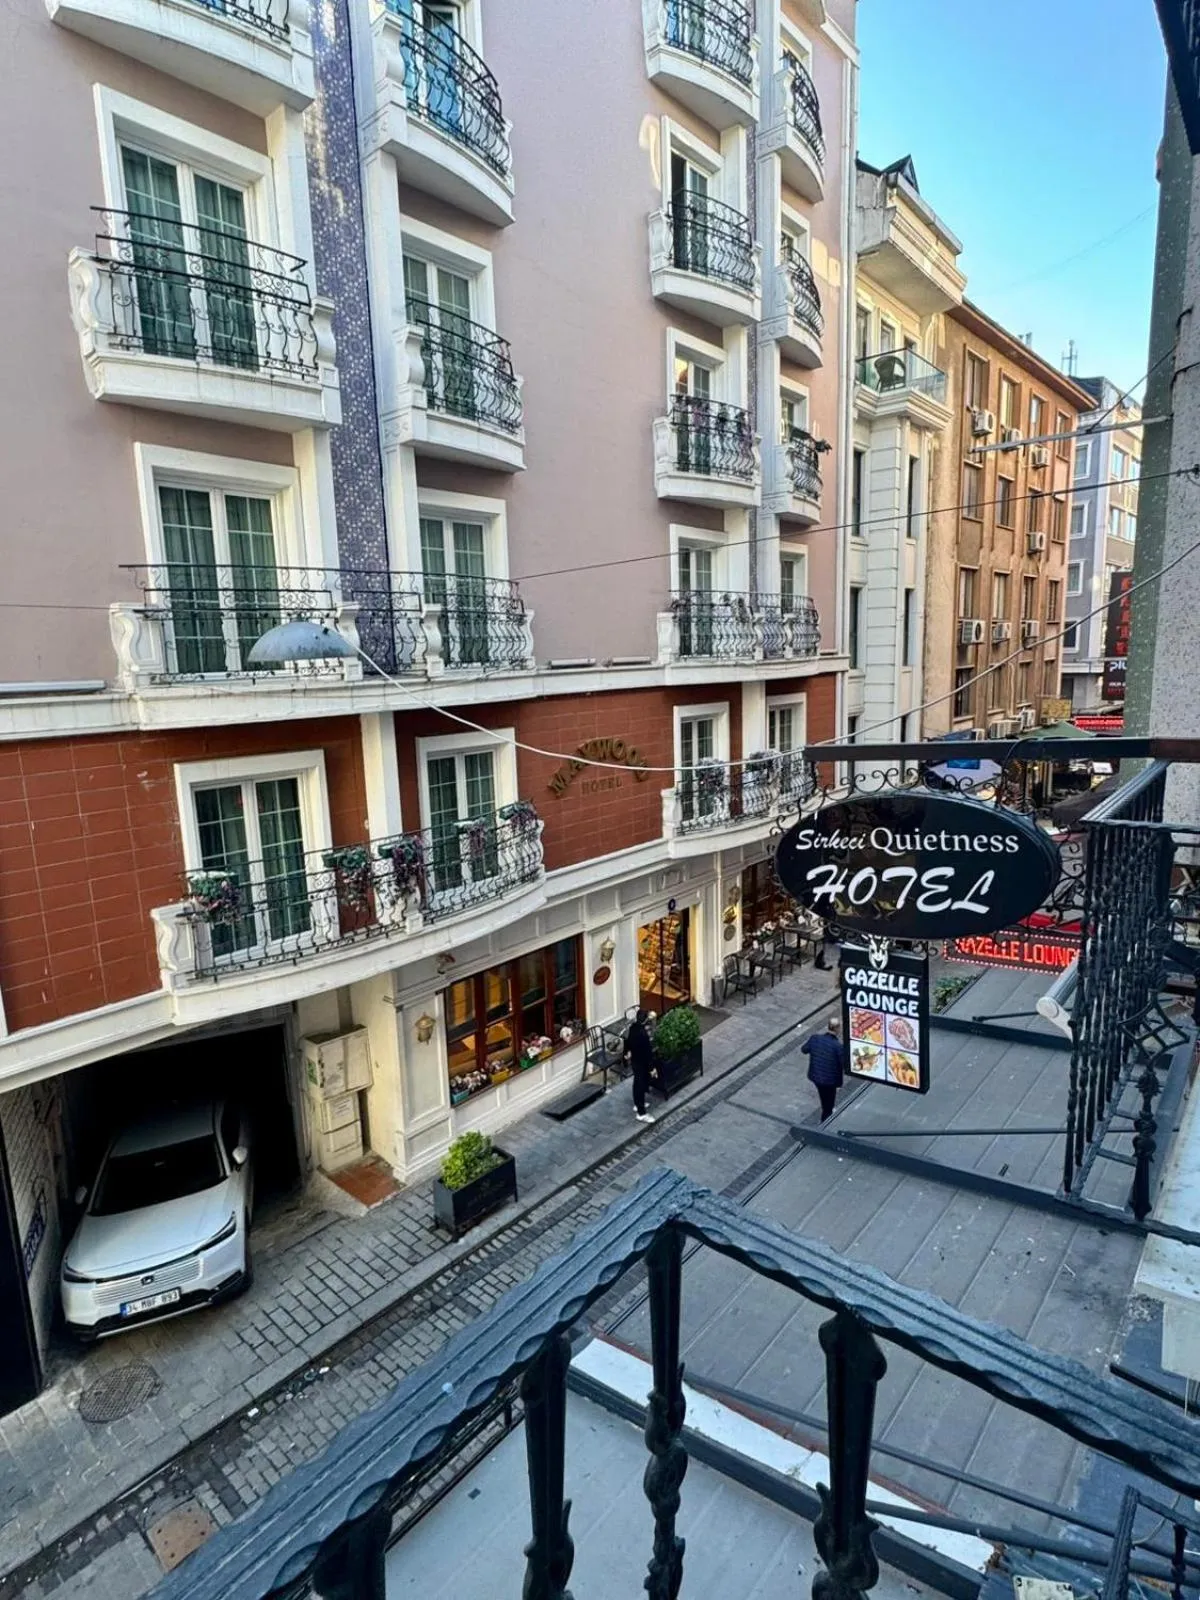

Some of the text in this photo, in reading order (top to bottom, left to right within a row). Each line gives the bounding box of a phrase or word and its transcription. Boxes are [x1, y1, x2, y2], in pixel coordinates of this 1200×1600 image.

[581, 776, 623, 794] HOTEL
[796, 827, 1020, 856] Sirkeci Quietness
[806, 864, 995, 914] HOTEL
[844, 966, 919, 997] GAZELLE
[845, 987, 919, 1017] LOUNGE
